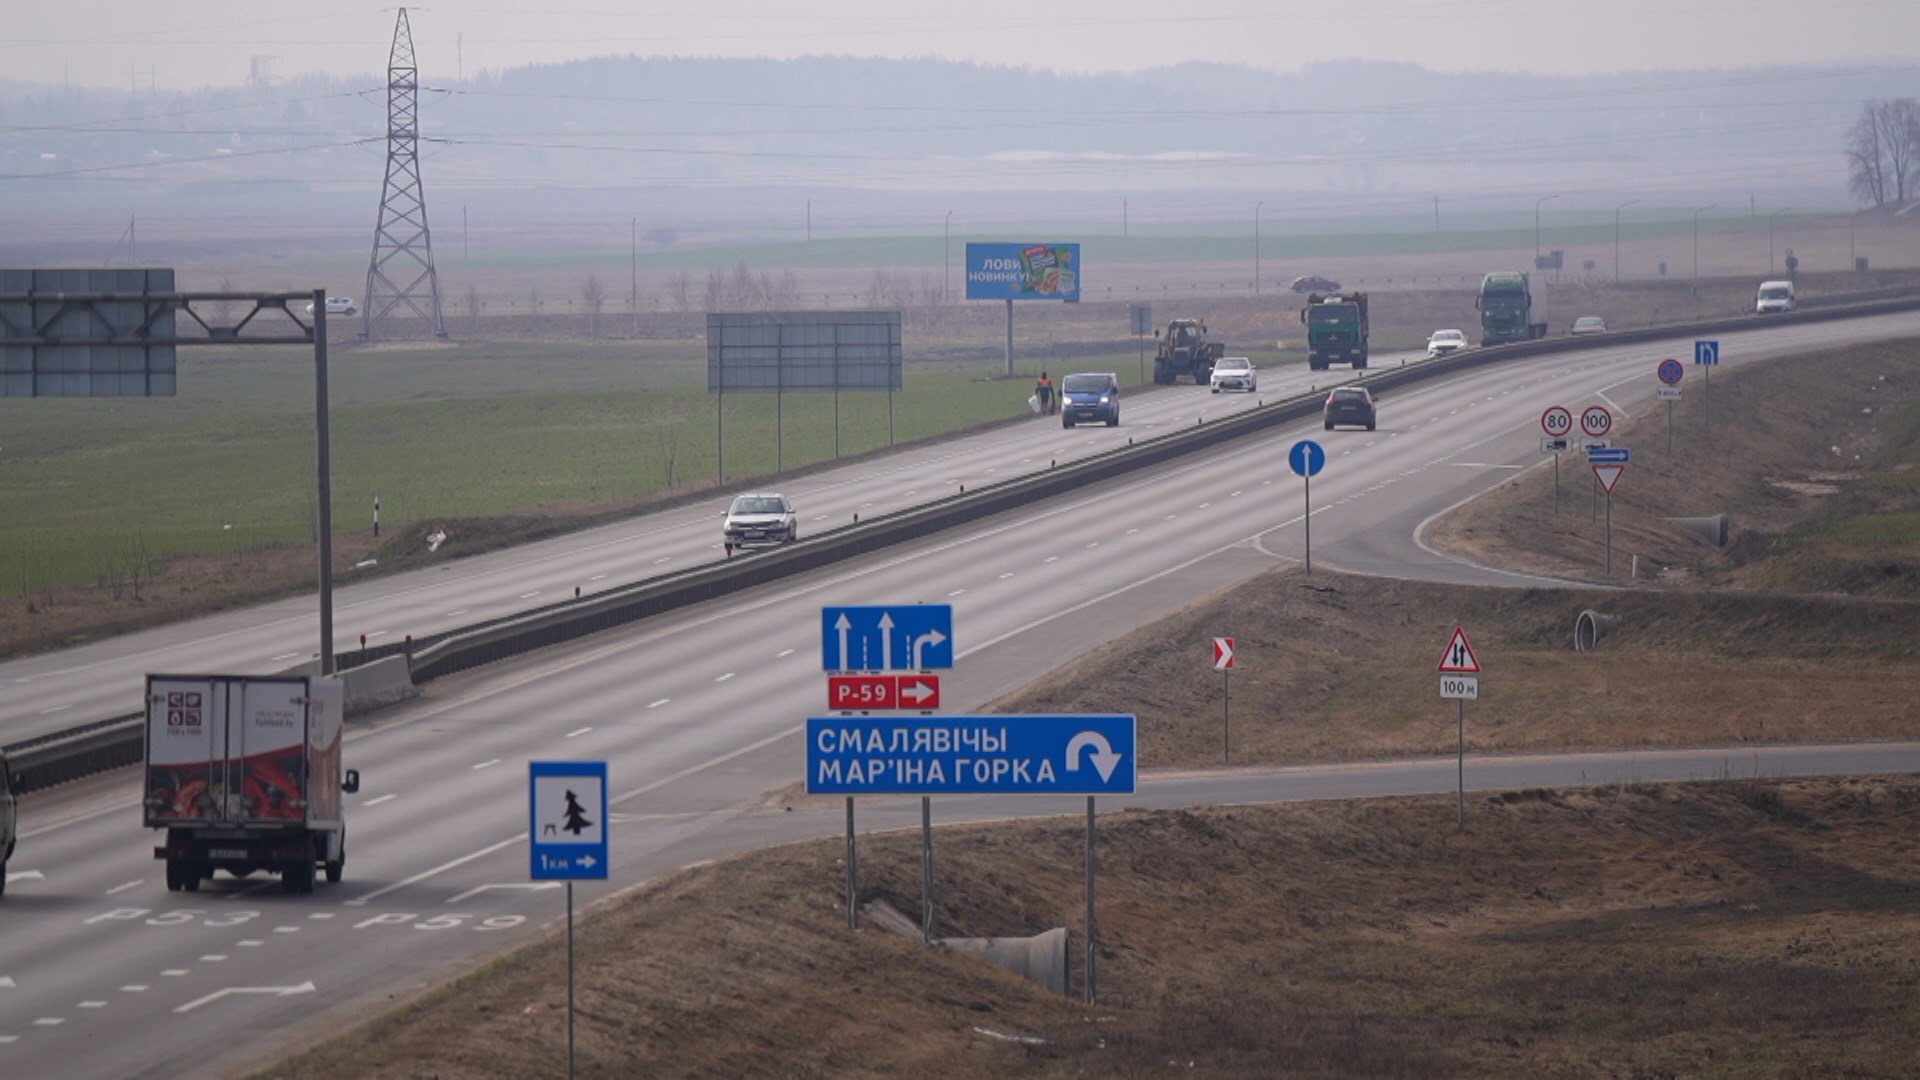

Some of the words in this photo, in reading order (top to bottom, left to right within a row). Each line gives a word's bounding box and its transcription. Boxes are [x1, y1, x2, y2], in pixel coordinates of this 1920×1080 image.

[982, 258, 1022, 271] ЛОВИ
[1547, 414, 1567, 429] 80
[1586, 414, 1608, 429] 100
[838, 684, 887, 702] Р-59
[1443, 681, 1465, 694] 100
[817, 728, 1007, 753] СМАЛЯВІЧЫ
[954, 758, 1056, 784] ГОРКА
